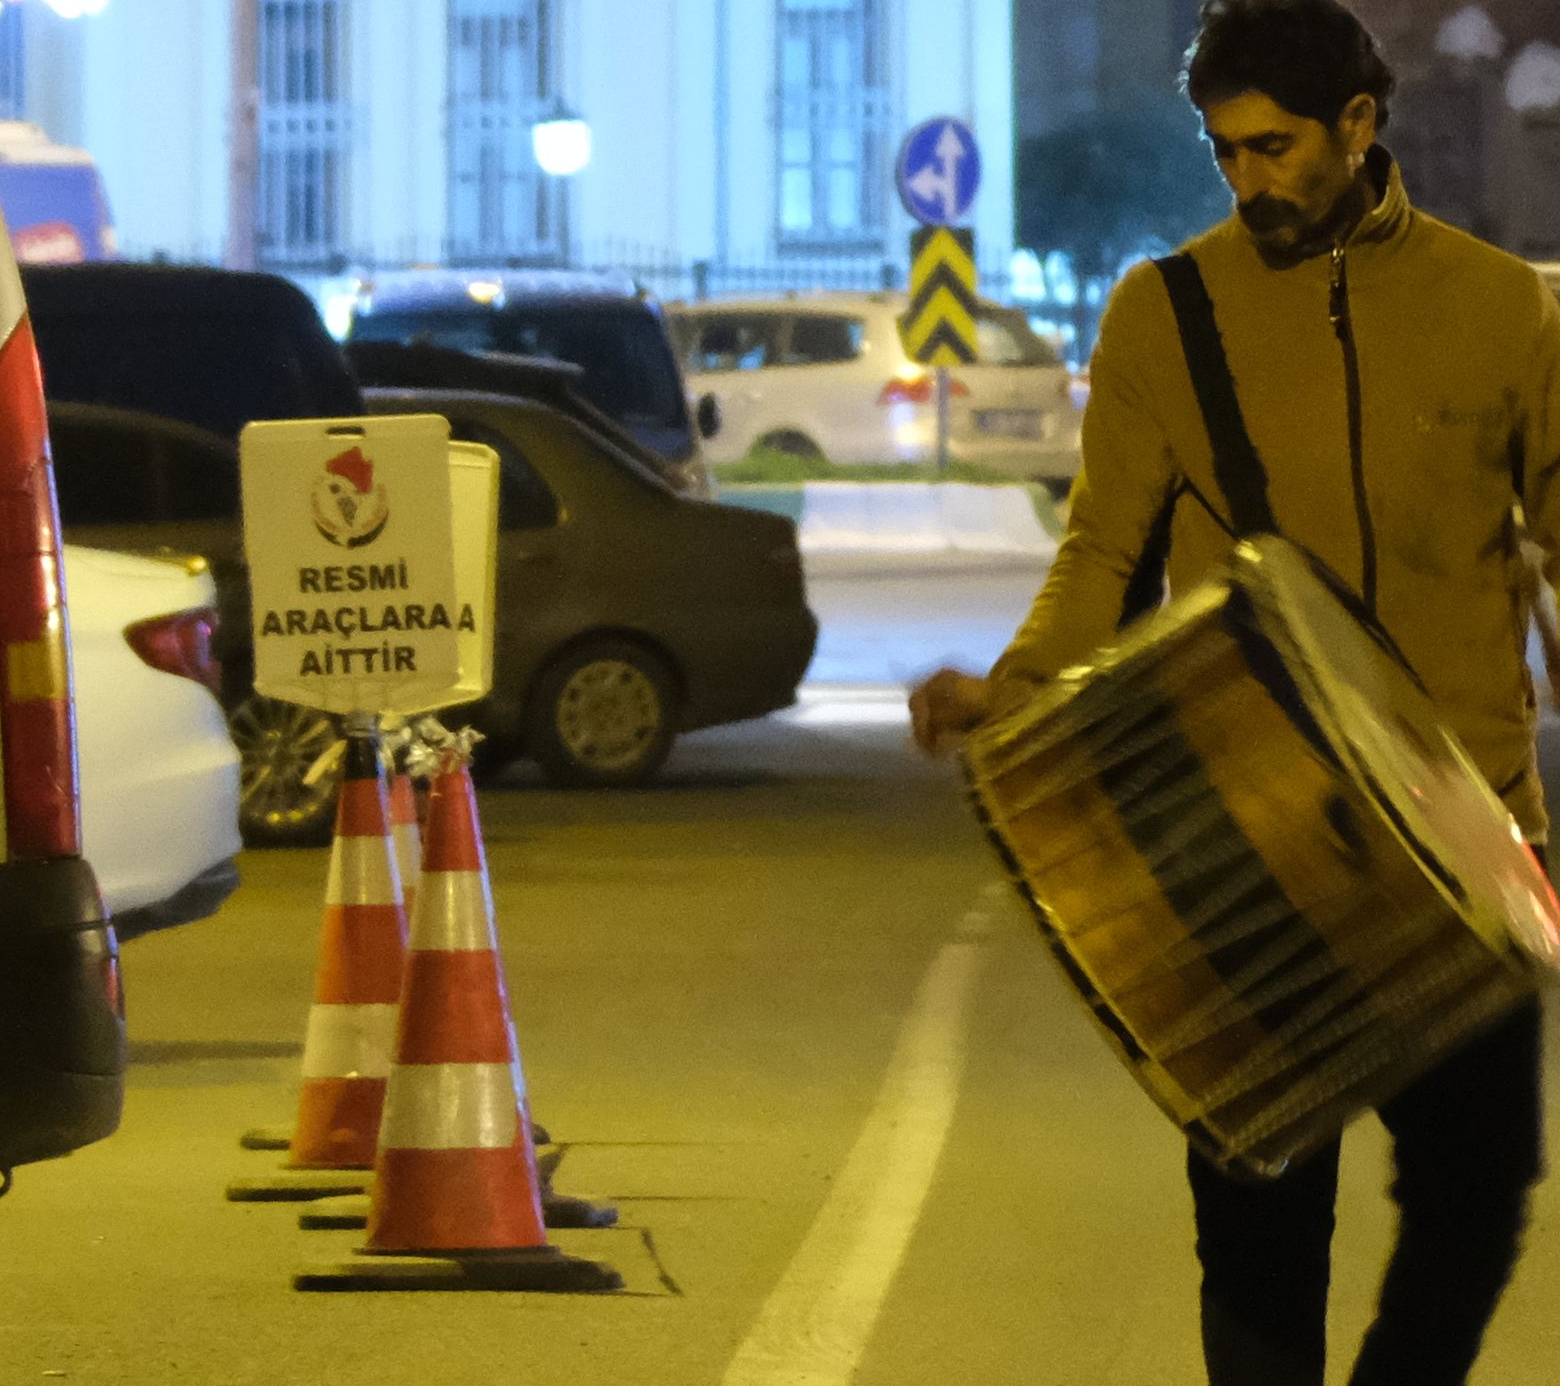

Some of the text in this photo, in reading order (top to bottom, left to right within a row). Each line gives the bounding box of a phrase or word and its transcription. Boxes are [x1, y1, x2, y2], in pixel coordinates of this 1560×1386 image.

[299, 557, 409, 594] RESMİ
[262, 602, 453, 641] ARAÇLARA
[299, 640, 417, 676] AİTTİR
